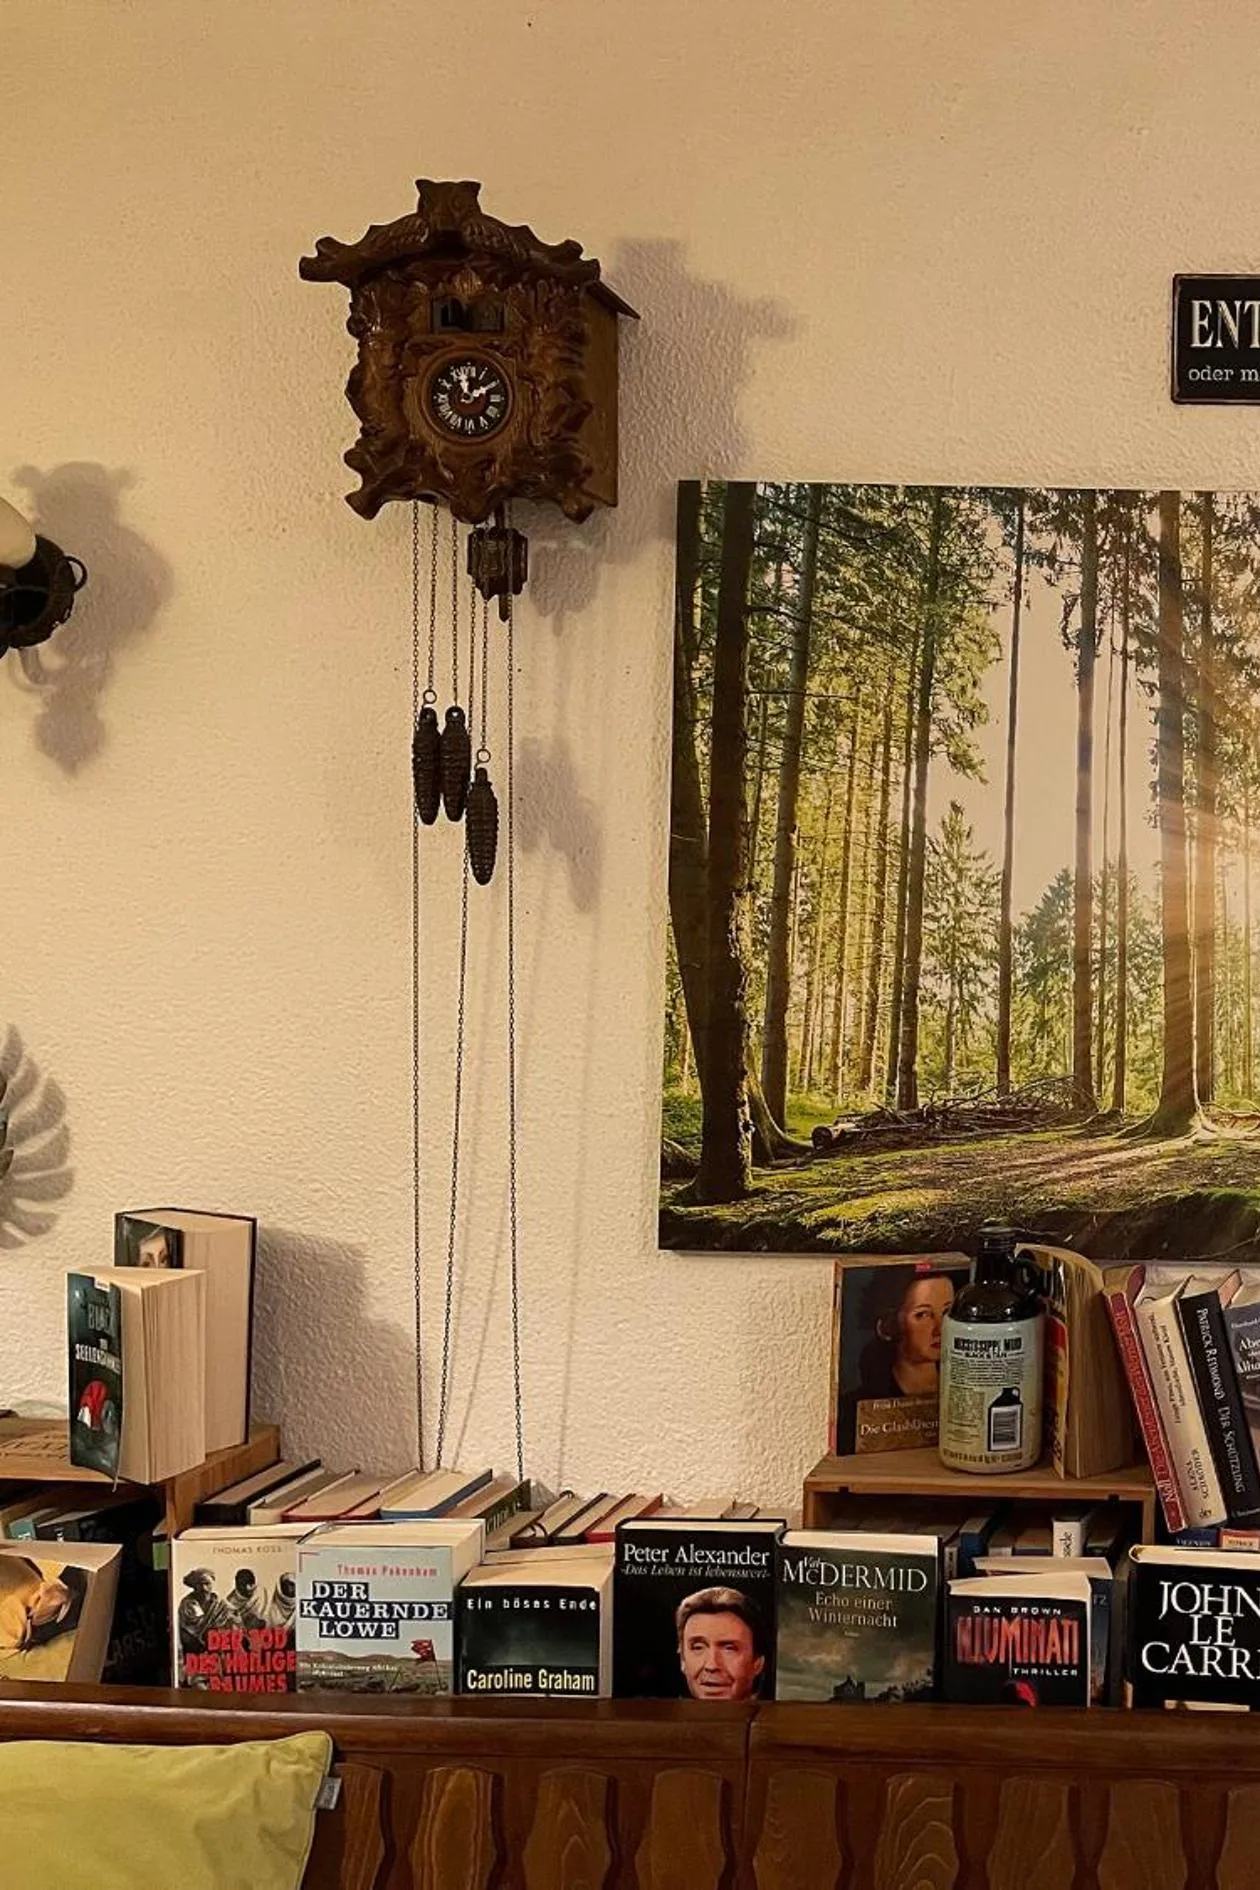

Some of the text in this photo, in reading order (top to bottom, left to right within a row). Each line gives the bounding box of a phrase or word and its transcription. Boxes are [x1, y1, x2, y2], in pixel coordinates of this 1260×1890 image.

[1188, 366, 1233, 381] oder
[1196, 1307, 1215, 1350] PATRICK
[1203, 1348, 1225, 1400] REDMOND
[1217, 1406, 1233, 1429] DER
[1157, 1478, 1176, 1504] Noll
[212, 1547, 253, 1555] THOMAS
[624, 1543, 770, 1566] Peter Alexander
[337, 1563, 437, 1577] Thomas Pakenham
[651, 1564, 685, 1576] Leben
[689, 1565, 702, 1577] ist
[314, 1583, 367, 1600] DER
[815, 1591, 892, 1610] Echo einer
[301, 1601, 448, 1619] KAUERNDE
[467, 1597, 597, 1611] Ein böses Ende
[973, 1605, 1061, 1615] DAN BROWN
[808, 1607, 898, 1629] Winternacht
[320, 1620, 396, 1637] LÖWE
[1190, 1614, 1236, 1647] LE
[208, 1627, 287, 1651] DER TOD
[956, 1616, 1079, 1668] ILLUMINATI
[186, 1650, 297, 1675] DES HEILIGE
[1011, 1667, 1078, 1676] THRILLER
[467, 1668, 595, 1692] Caroline Graham
